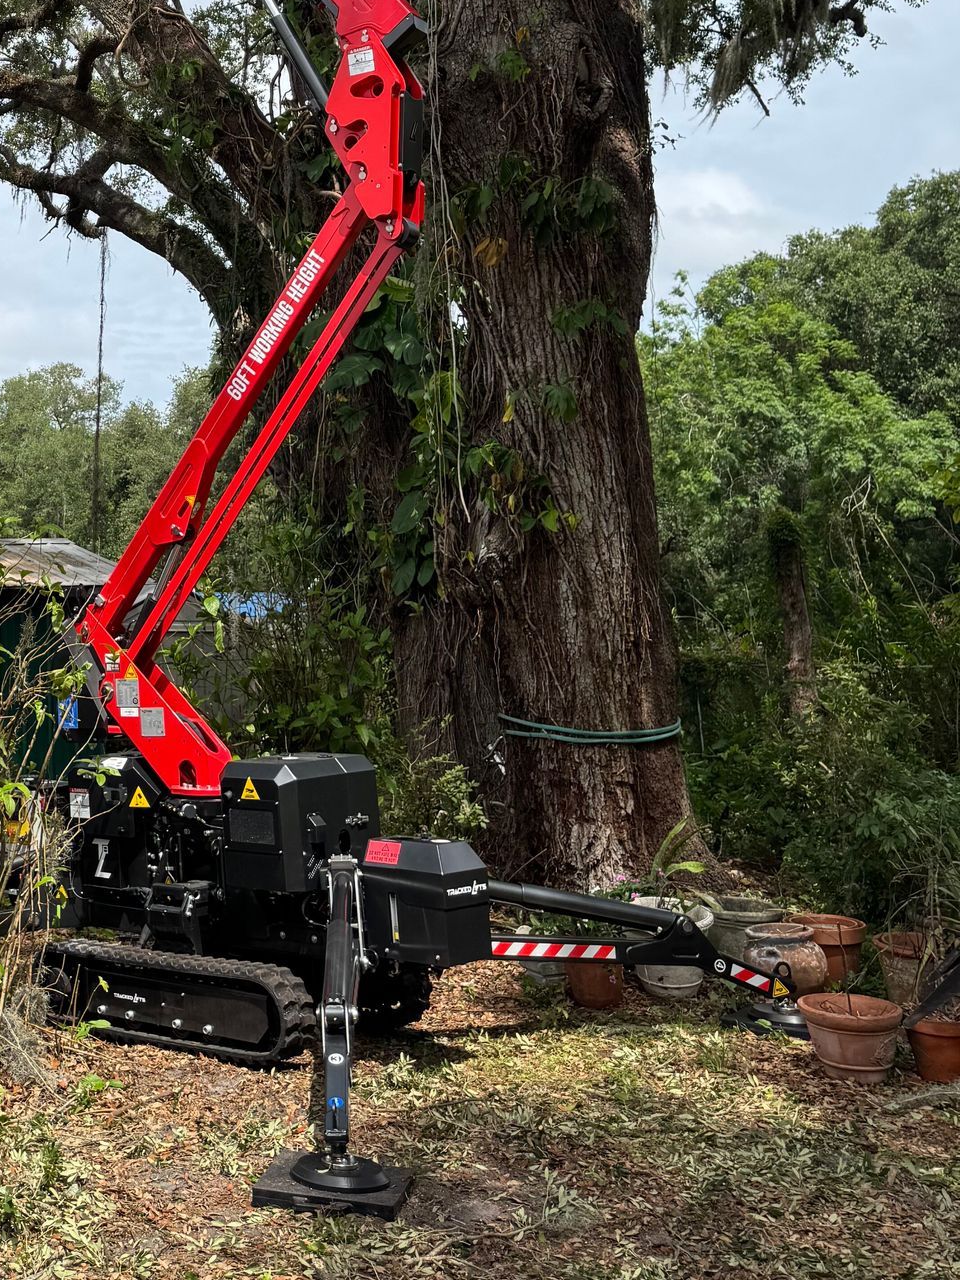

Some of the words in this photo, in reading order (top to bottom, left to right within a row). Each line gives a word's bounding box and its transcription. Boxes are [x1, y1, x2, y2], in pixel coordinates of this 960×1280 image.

[227, 360, 256, 401] 60FT
[248, 300, 295, 365] WORKING
[286, 248, 325, 303] HEIGHT
[446, 886, 472, 896] TRACKED
[471, 880, 487, 895] LIFTS
[113, 992, 133, 1001] TRACKED
